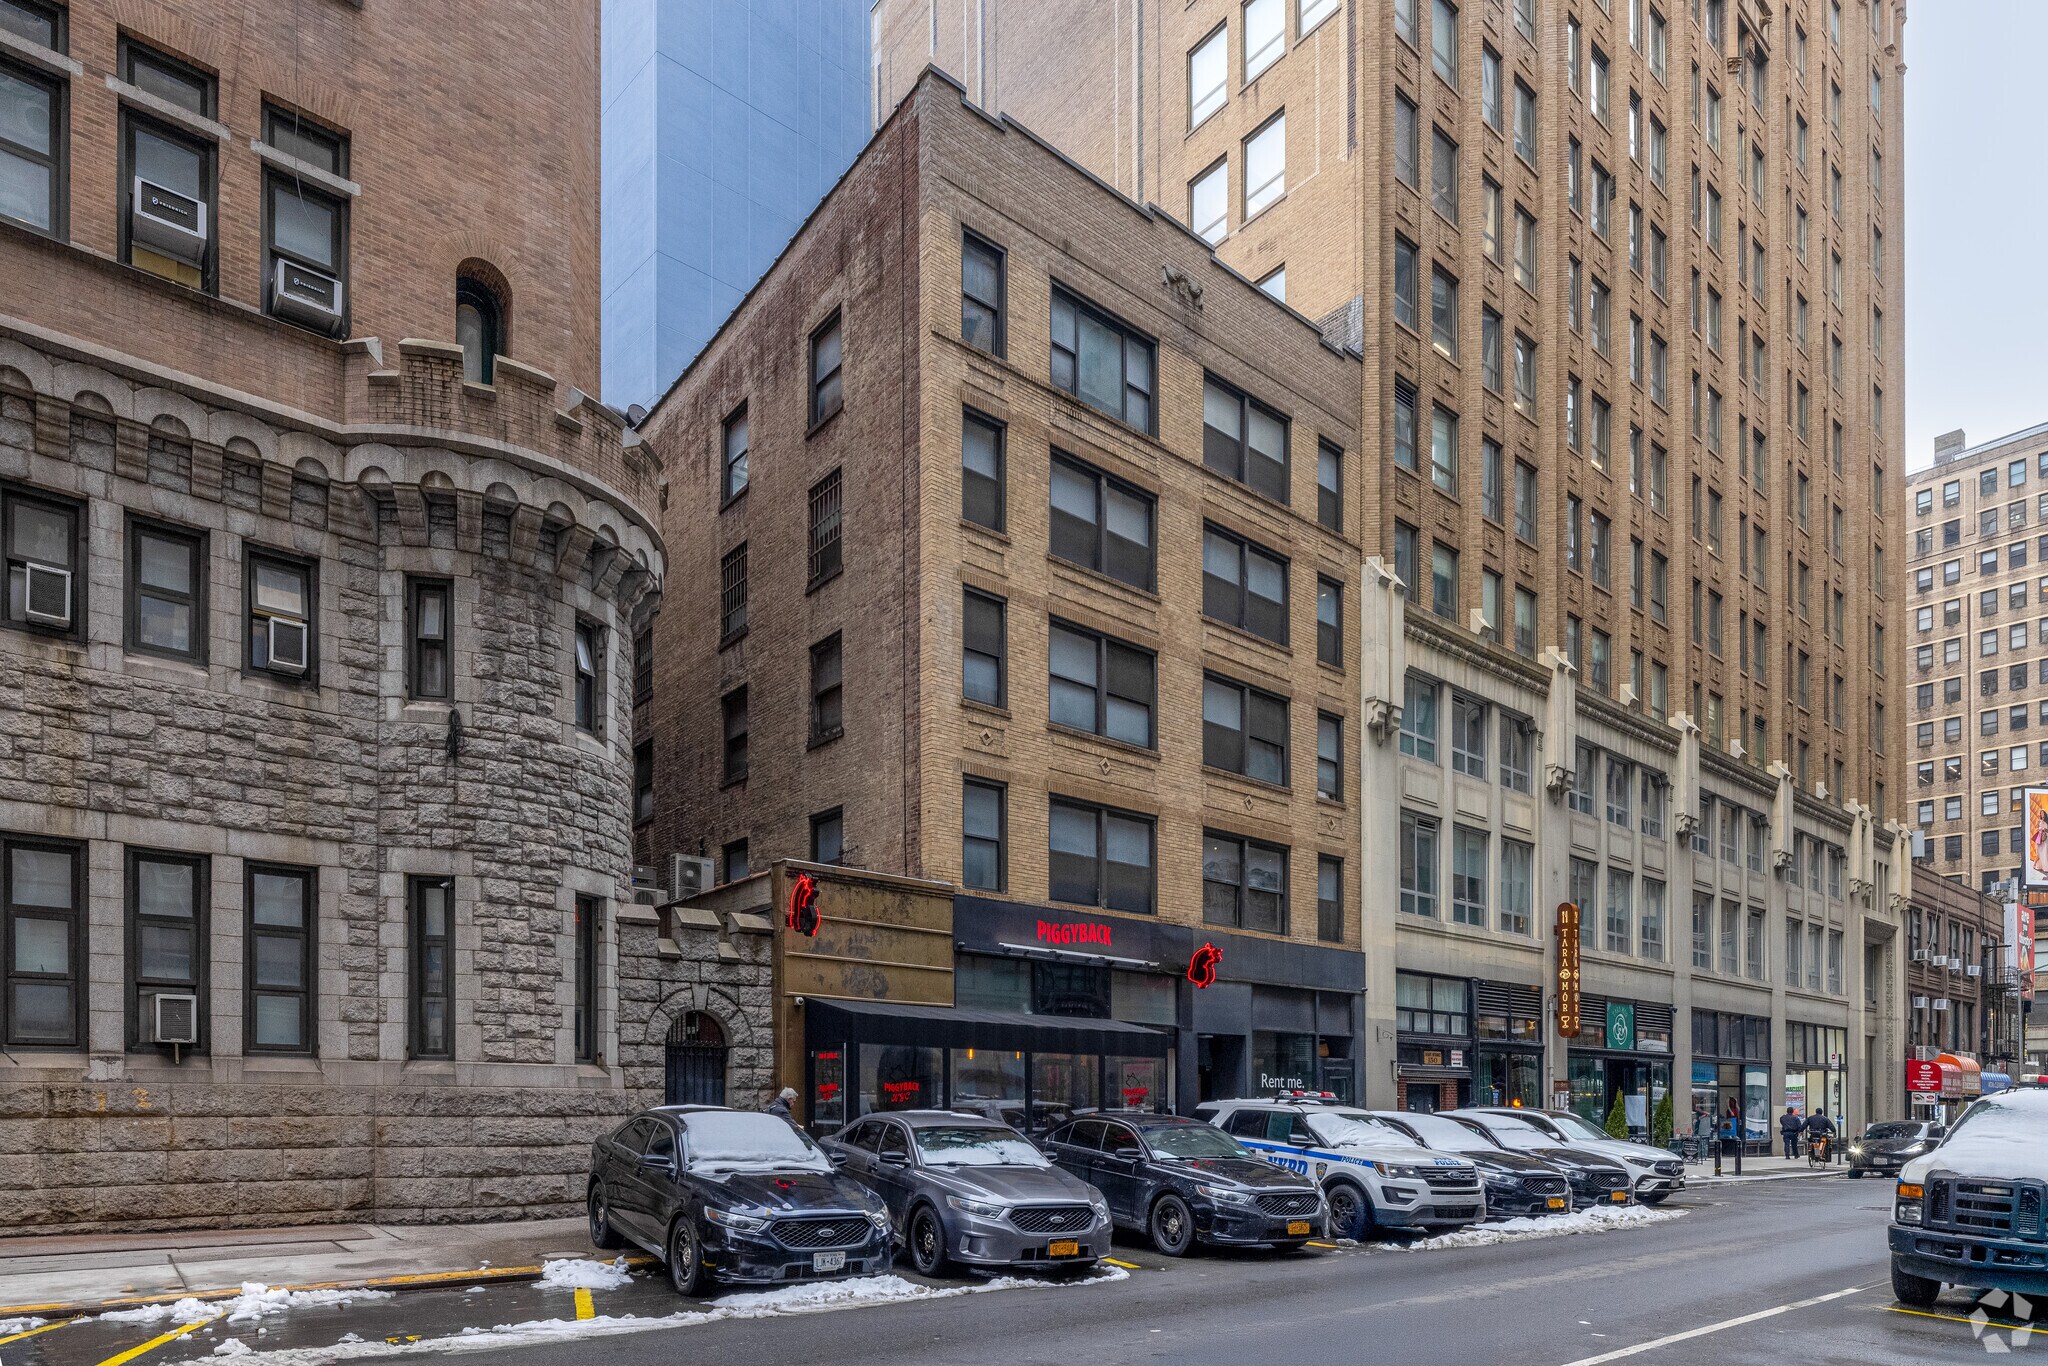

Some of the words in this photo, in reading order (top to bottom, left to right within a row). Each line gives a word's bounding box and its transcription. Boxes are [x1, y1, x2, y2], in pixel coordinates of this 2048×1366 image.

[159, 201, 188, 216] FRIEDRICH
[299, 281, 326, 294] FRIEDRICH
[1037, 920, 1112, 947] PIGGYBACK
[1561, 928, 1569, 967] TARA
[883, 1082, 920, 1092] PIGGYBACK
[1261, 1073, 1285, 1088] Rent
[1287, 1077, 1305, 1089] me.
[1341, 1156, 1363, 1166] POLICE
